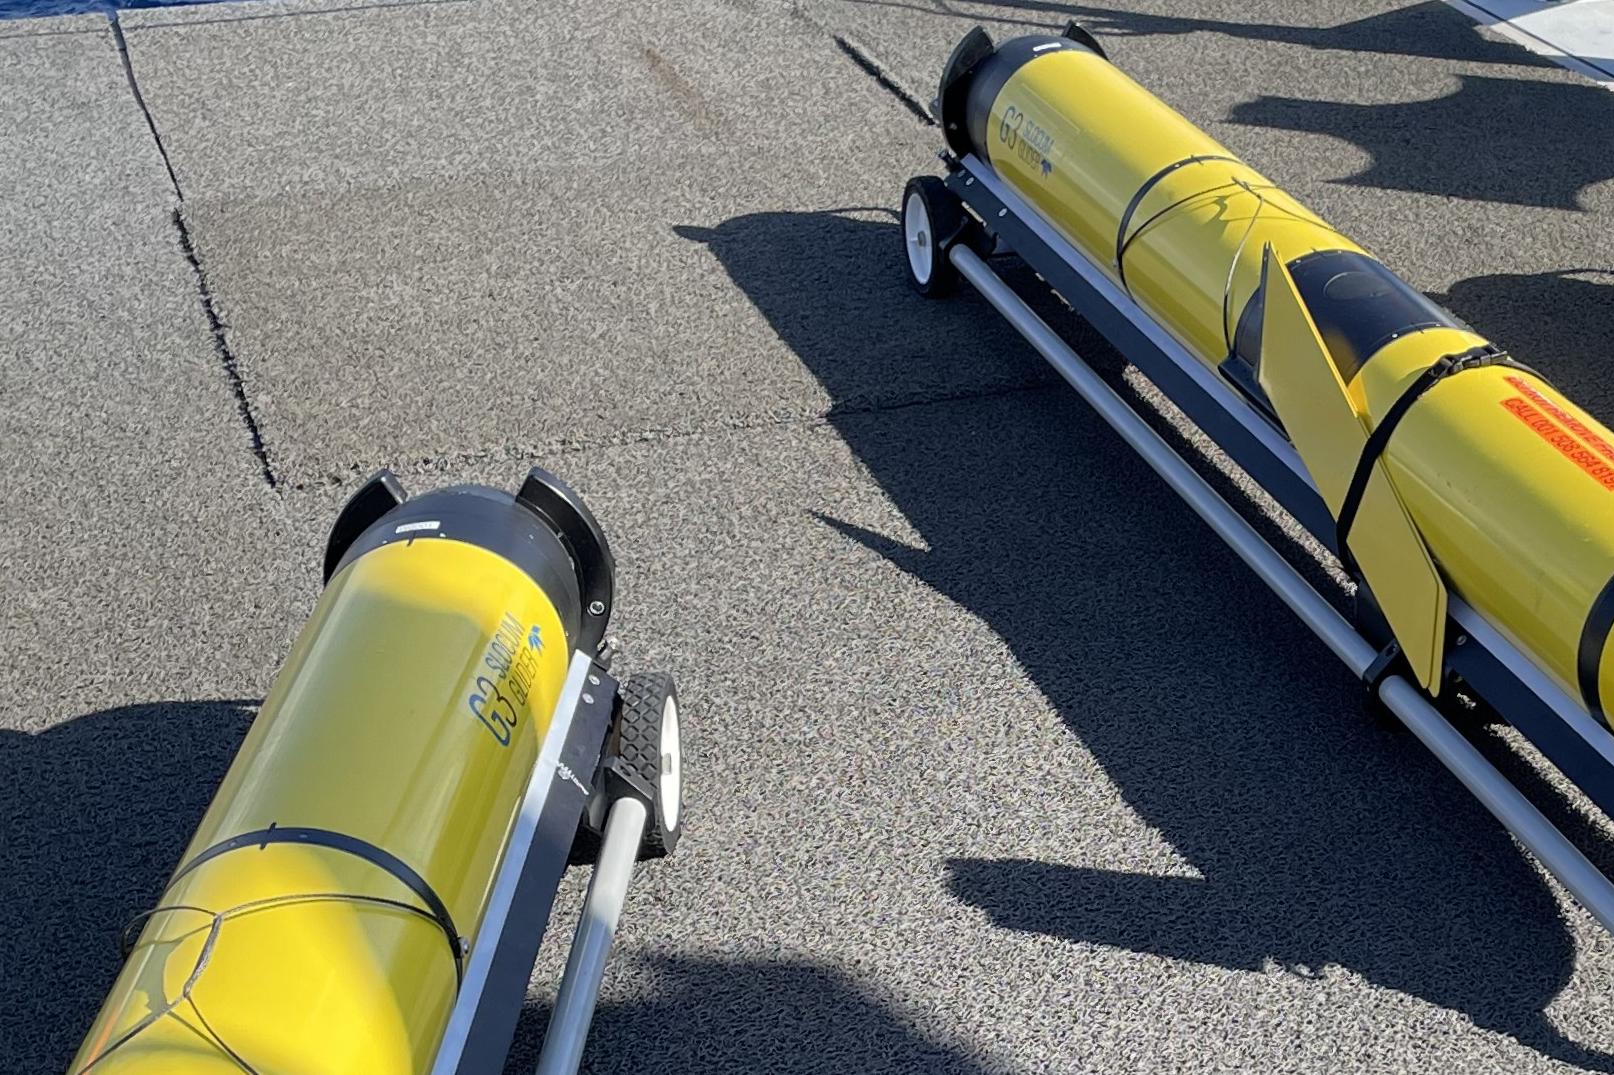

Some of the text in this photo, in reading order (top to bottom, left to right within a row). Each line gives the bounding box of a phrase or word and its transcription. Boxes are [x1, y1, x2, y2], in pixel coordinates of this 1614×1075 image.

[1000, 105, 1024, 150] G3
[1503, 398, 1540, 422] CALL
[484, 611, 526, 680] SLOCUM
[508, 646, 540, 707] GLIDER
[468, 675, 518, 747] G3
